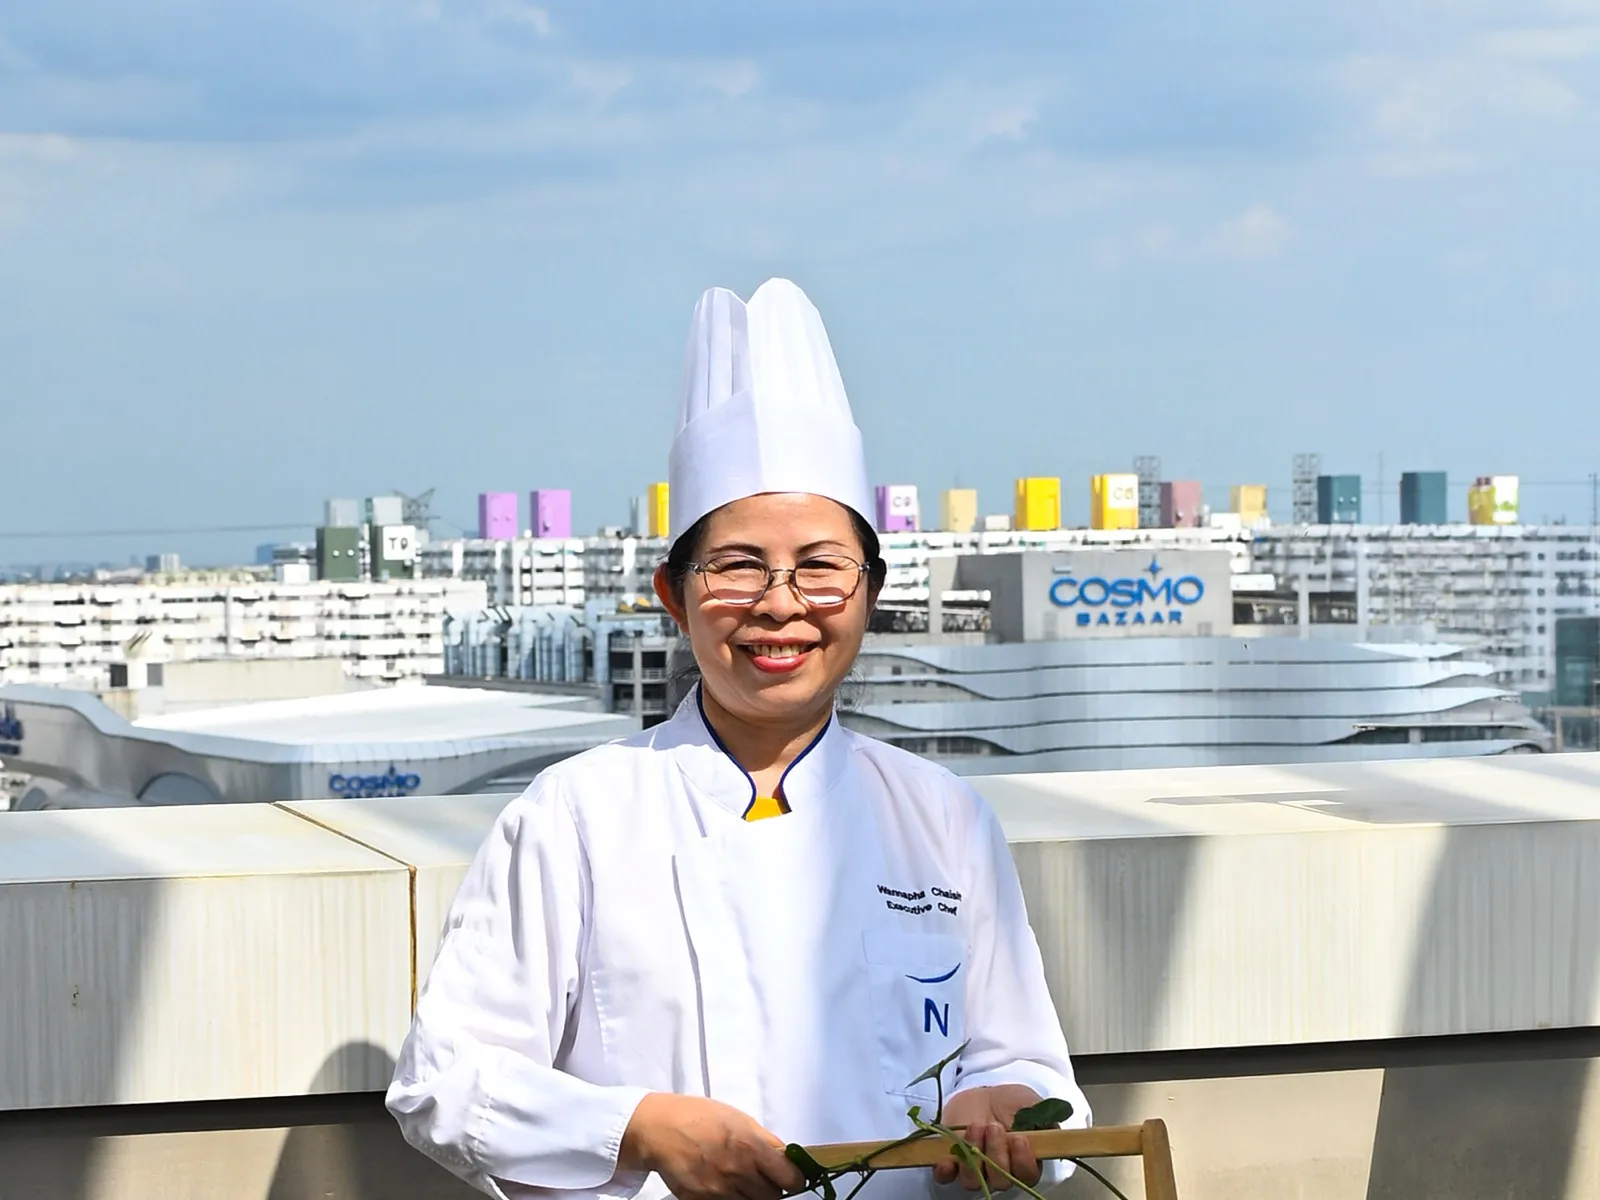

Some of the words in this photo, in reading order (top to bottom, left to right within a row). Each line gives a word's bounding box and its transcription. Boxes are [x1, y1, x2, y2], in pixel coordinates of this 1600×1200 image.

[1049, 576, 1204, 607] COSMO
[1076, 609, 1183, 626] BAZAAR
[328, 773, 421, 792] COSMO
[886, 900, 933, 915] Executive
[937, 902, 957, 916] Chef
[924, 998, 949, 1037] N
